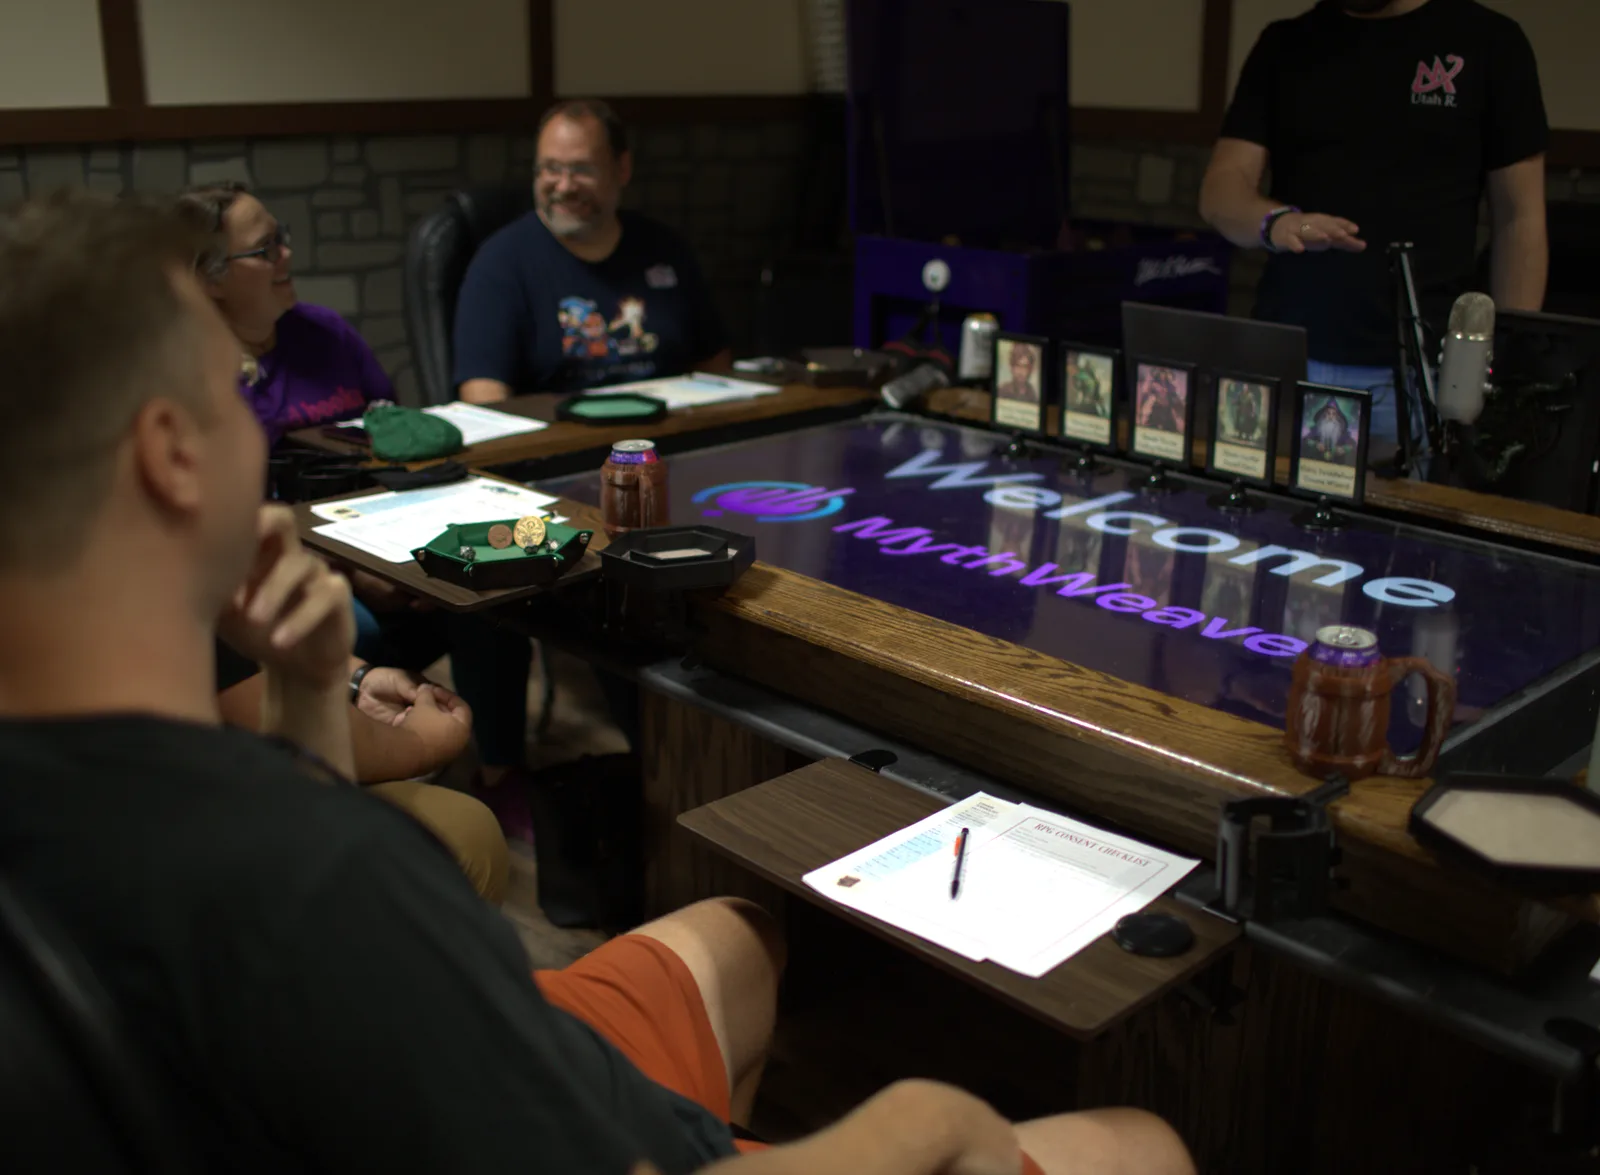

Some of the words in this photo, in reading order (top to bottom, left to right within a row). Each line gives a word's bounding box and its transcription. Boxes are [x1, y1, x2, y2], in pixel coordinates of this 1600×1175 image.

[1410, 93, 1442, 106] Utah
[885, 448, 1457, 608] Welcome
[1034, 823, 1055, 834] RPG
[1055, 831, 1098, 849] CONSENT
[1098, 845, 1151, 867] CHECKLIST
